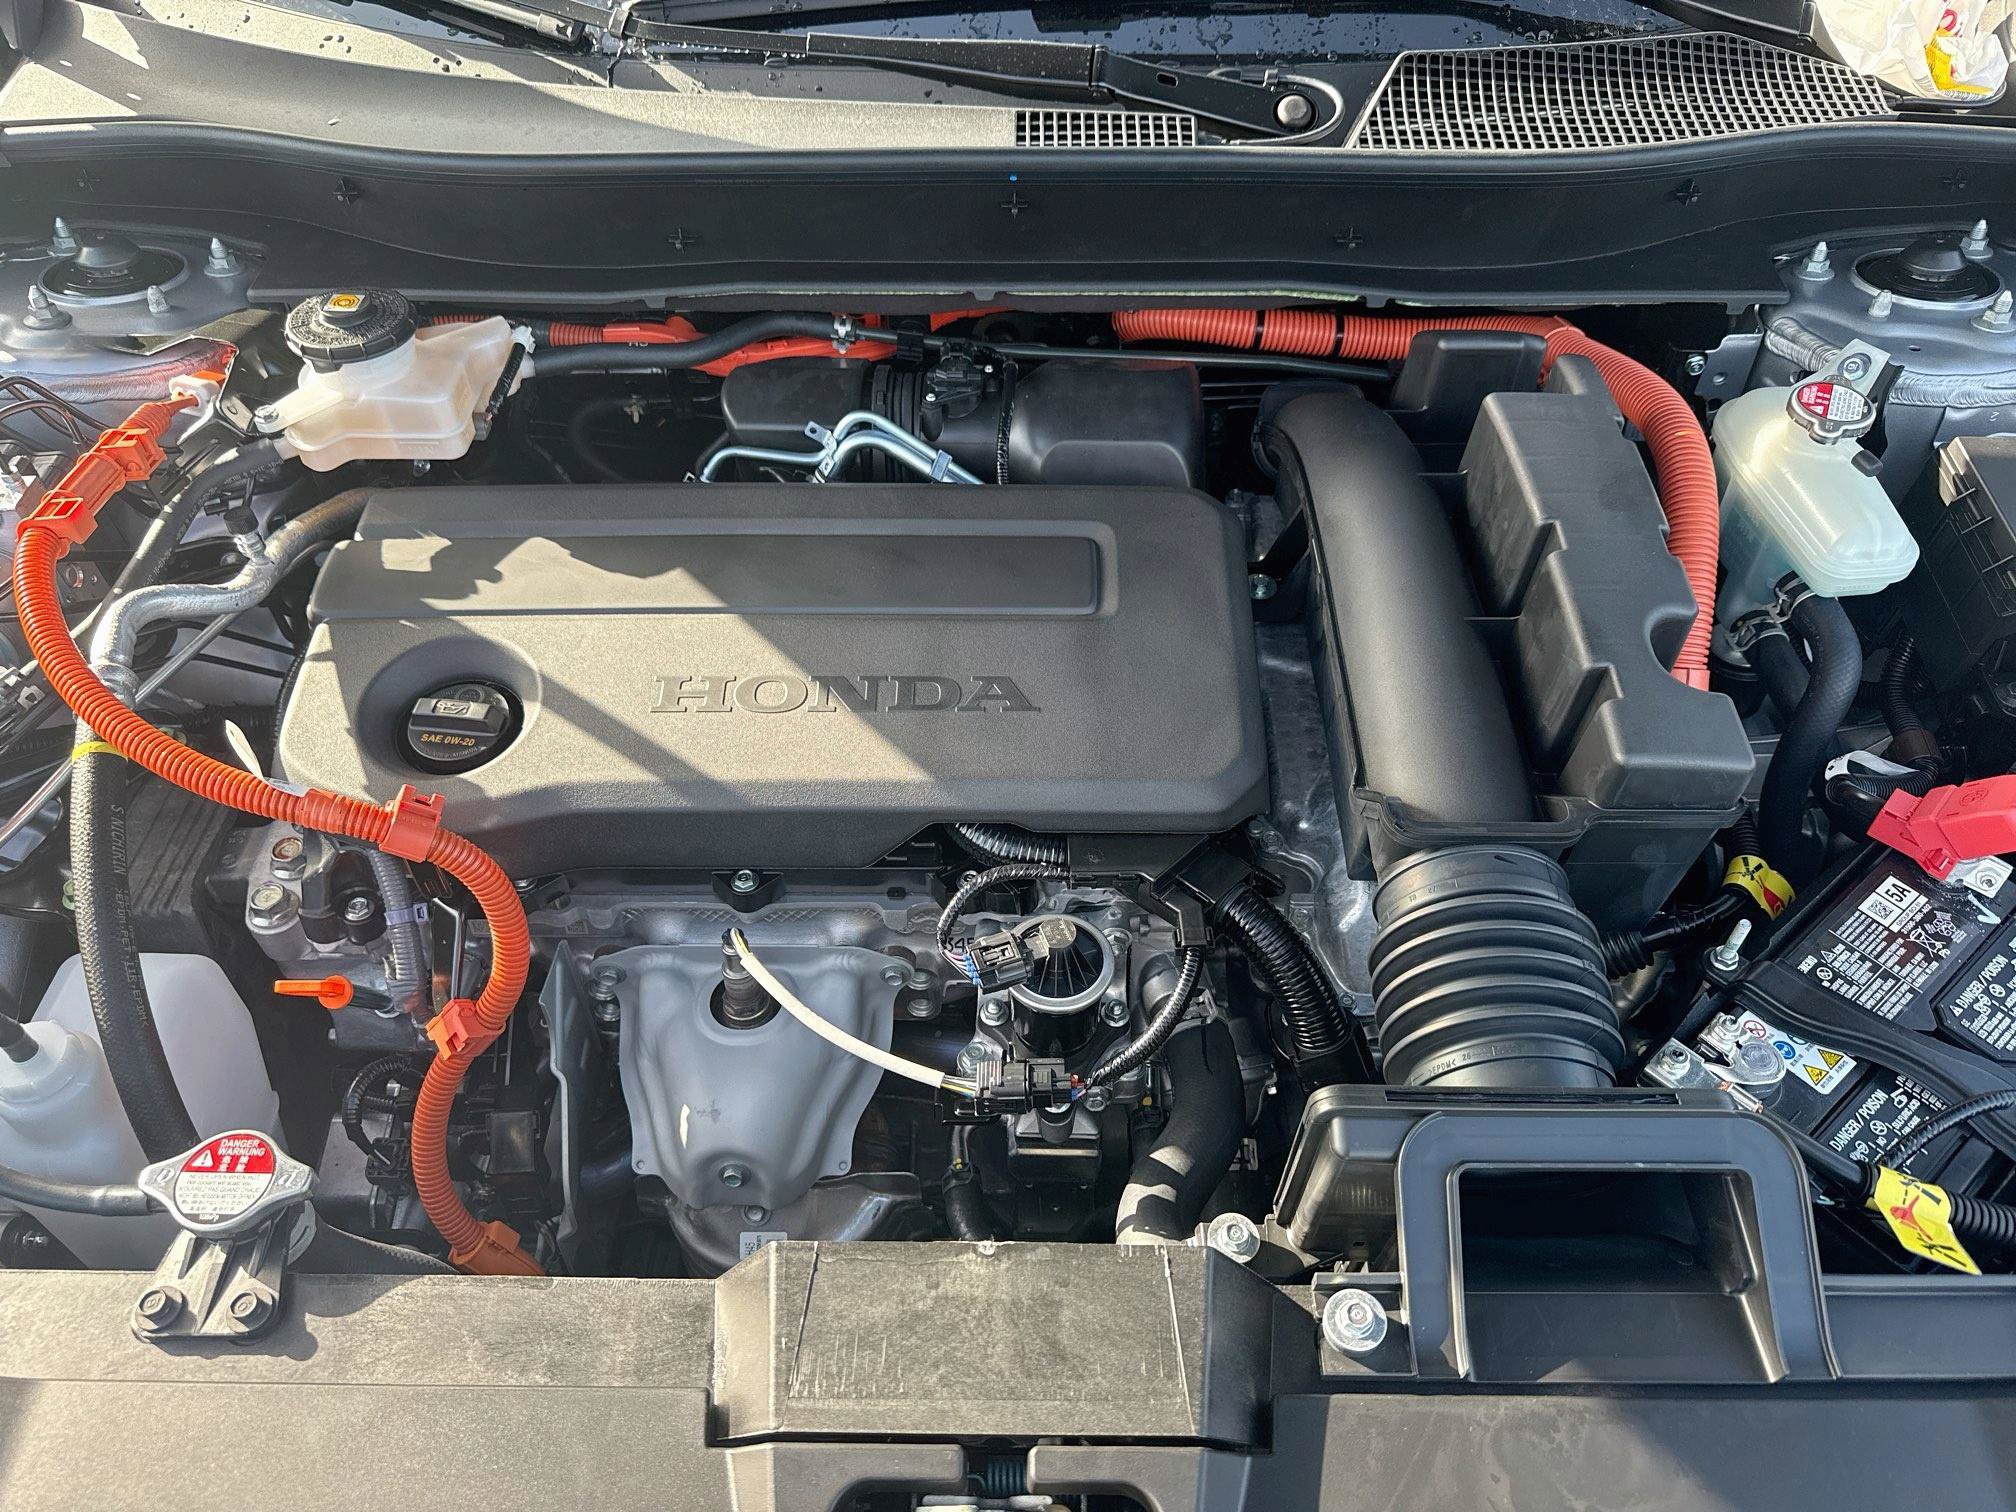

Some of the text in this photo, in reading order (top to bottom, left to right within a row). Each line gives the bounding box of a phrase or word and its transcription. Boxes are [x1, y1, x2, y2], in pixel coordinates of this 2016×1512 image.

[650, 675, 1041, 713] HONDA
[421, 733, 475, 747] SAE 0W-20
[1885, 883, 1911, 902] 5A
[220, 1139, 260, 1148] DANGER
[218, 1147, 266, 1157] WARNUNG
